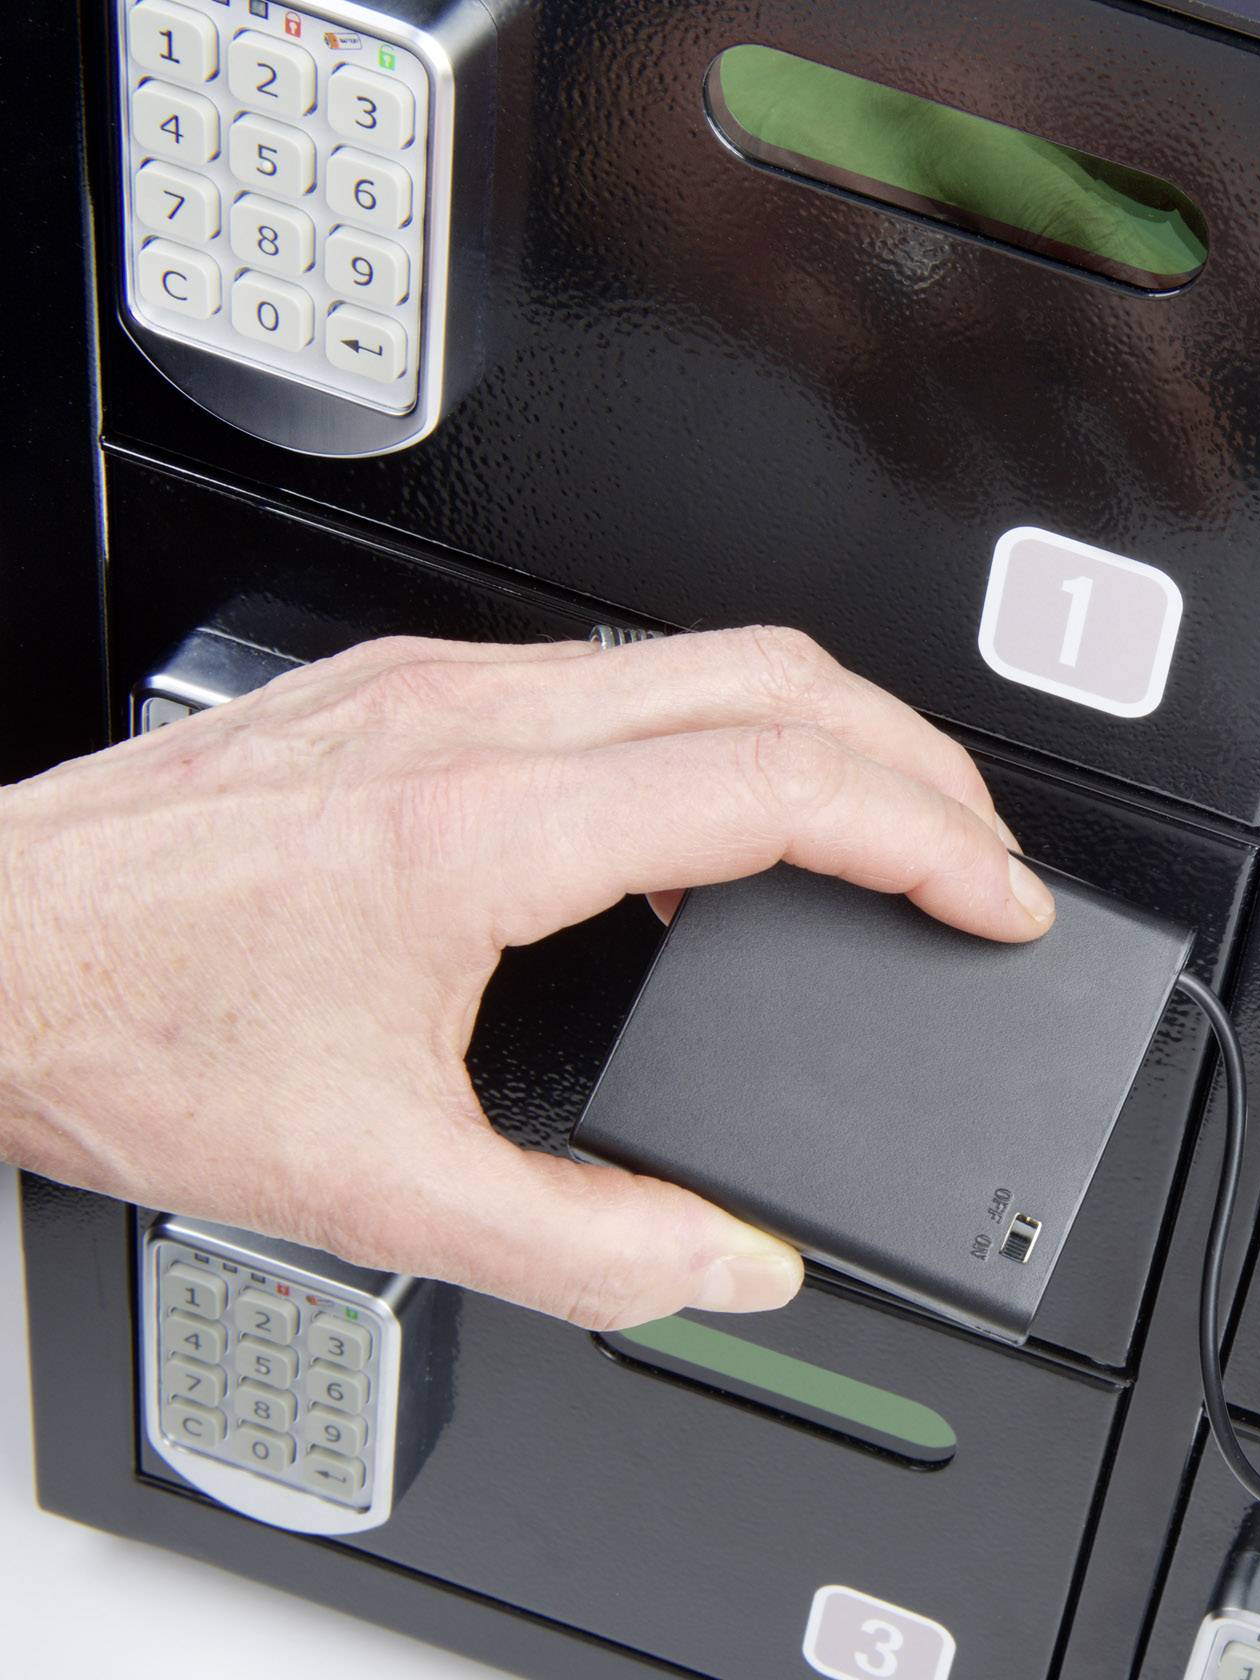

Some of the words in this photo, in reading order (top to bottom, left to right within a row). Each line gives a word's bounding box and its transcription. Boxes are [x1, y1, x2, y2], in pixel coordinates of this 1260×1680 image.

[159, 29, 181, 65] 1
[256, 62, 279, 99] 2
[355, 95, 378, 130] 3
[159, 114, 185, 145] 4
[255, 143, 278, 177] 5
[353, 178, 377, 211] 6
[163, 190, 186, 220] 7
[257, 225, 280, 257] 8
[351, 256, 374, 287] 9
[161, 270, 188, 302] C
[256, 300, 280, 332] 0
[1059, 576, 1093, 668] 1
[184, 1287, 201, 1308] 1
[254, 1310, 273, 1333] 2
[327, 1335, 345, 1357] 3
[183, 1332, 203, 1351] 4
[254, 1355, 273, 1377] 5
[325, 1381, 345, 1402] 6
[181, 1416, 204, 1438] C
[251, 1440, 271, 1461] 0
[184, 1373, 203, 1393] 7
[253, 1399, 272, 1421] 8
[323, 1423, 343, 1444] 9
[855, 1619, 903, 1677] 3
